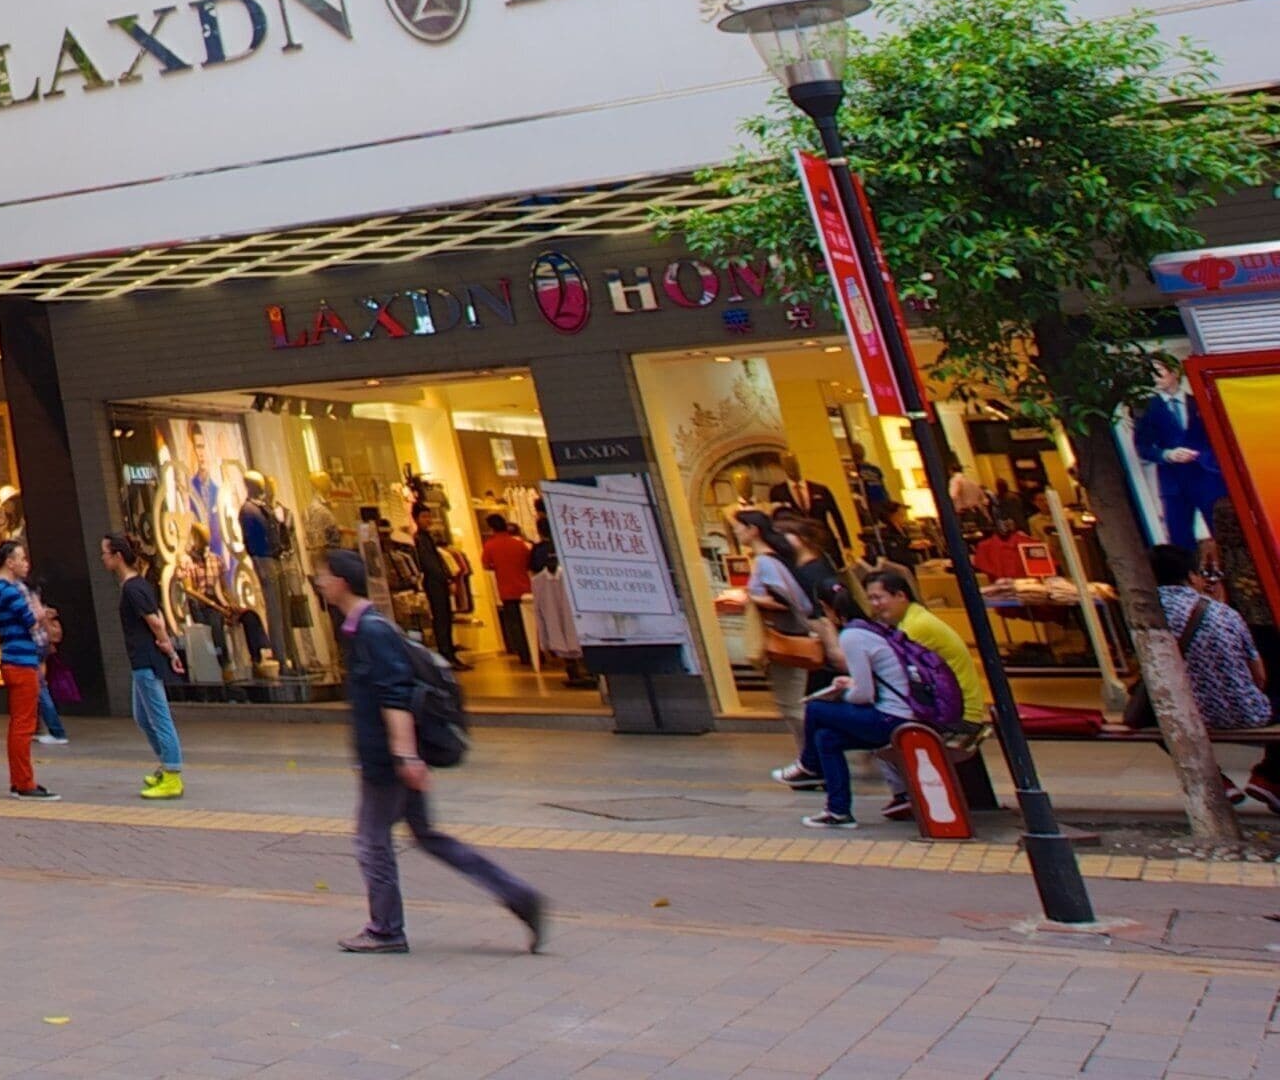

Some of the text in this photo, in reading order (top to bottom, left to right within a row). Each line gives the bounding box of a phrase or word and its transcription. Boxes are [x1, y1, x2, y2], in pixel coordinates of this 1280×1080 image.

[265, 277, 517, 350] LAXDN
[564, 442, 631, 461] LAXDN
[560, 503, 642, 533] 春季精选
[563, 527, 649, 555] 货品优惠
